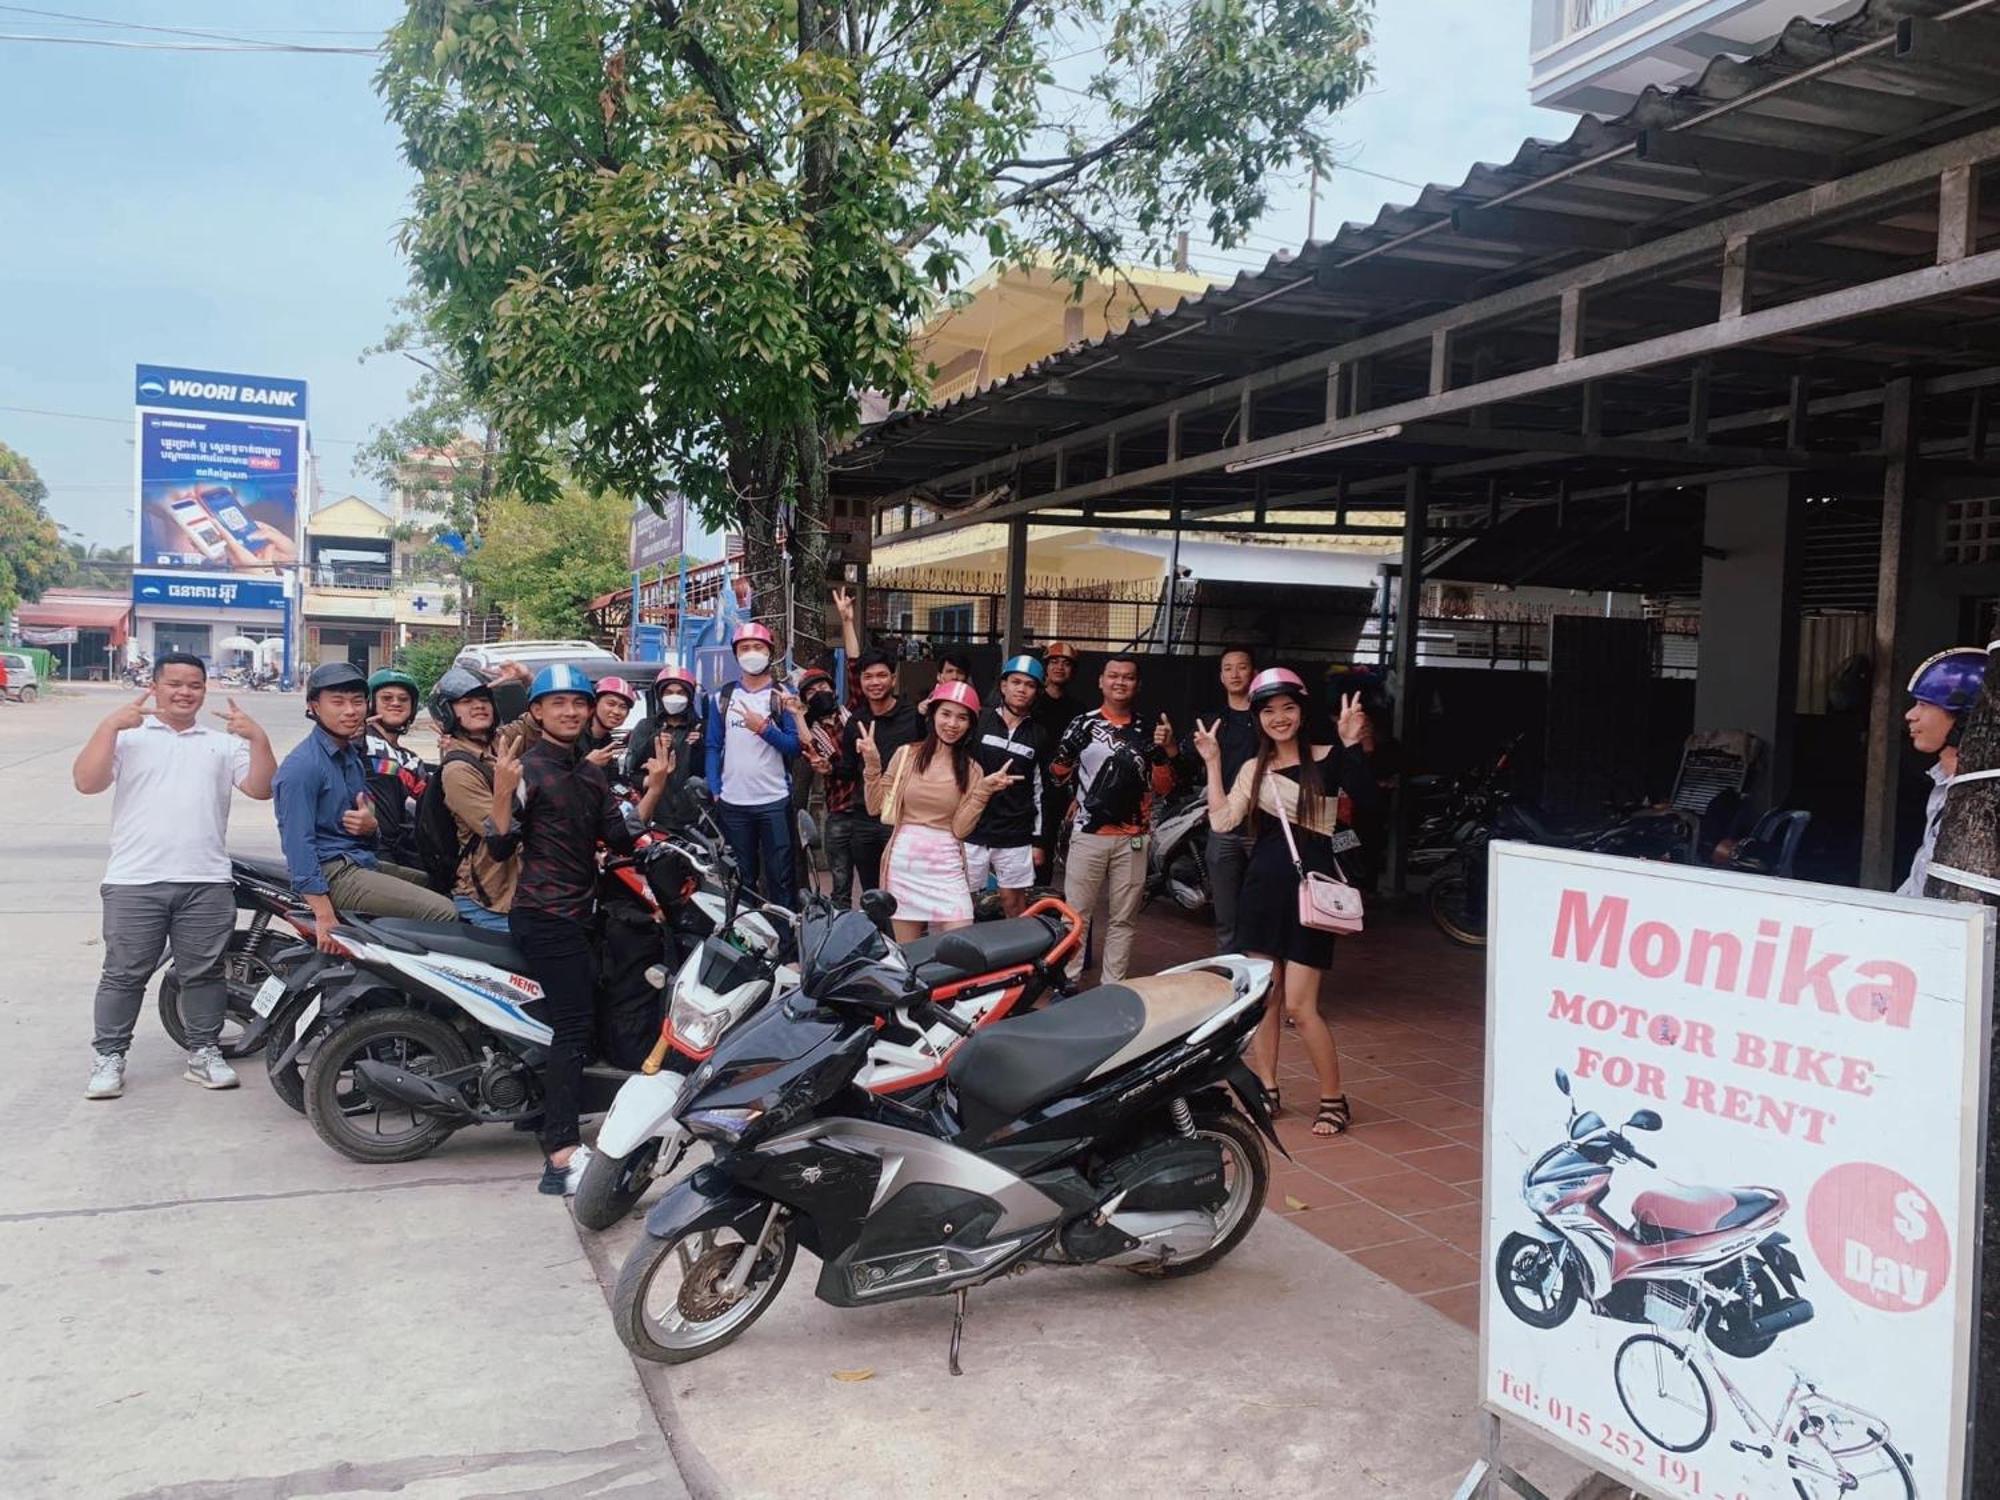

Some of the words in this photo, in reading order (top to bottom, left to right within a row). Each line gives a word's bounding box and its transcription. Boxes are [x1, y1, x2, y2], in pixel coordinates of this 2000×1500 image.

[169, 379, 237, 401] WOORI
[240, 387, 298, 407] BANK
[1551, 889, 1918, 1028] Monika
[1548, 990, 1717, 1058] MOTOR
[1732, 1032, 1876, 1097] BIKE
[1574, 1047, 1667, 1100] FOR
[1682, 1075, 1836, 1145] RENT
[1894, 1189, 1928, 1244] $
[1845, 1237, 1928, 1305] Day
[1499, 1371, 1539, 1410] Tel:
[1548, 1397, 1591, 1436] 015
[1599, 1423, 1645, 1466] 252
[1659, 1454, 1702, 1495] 191
